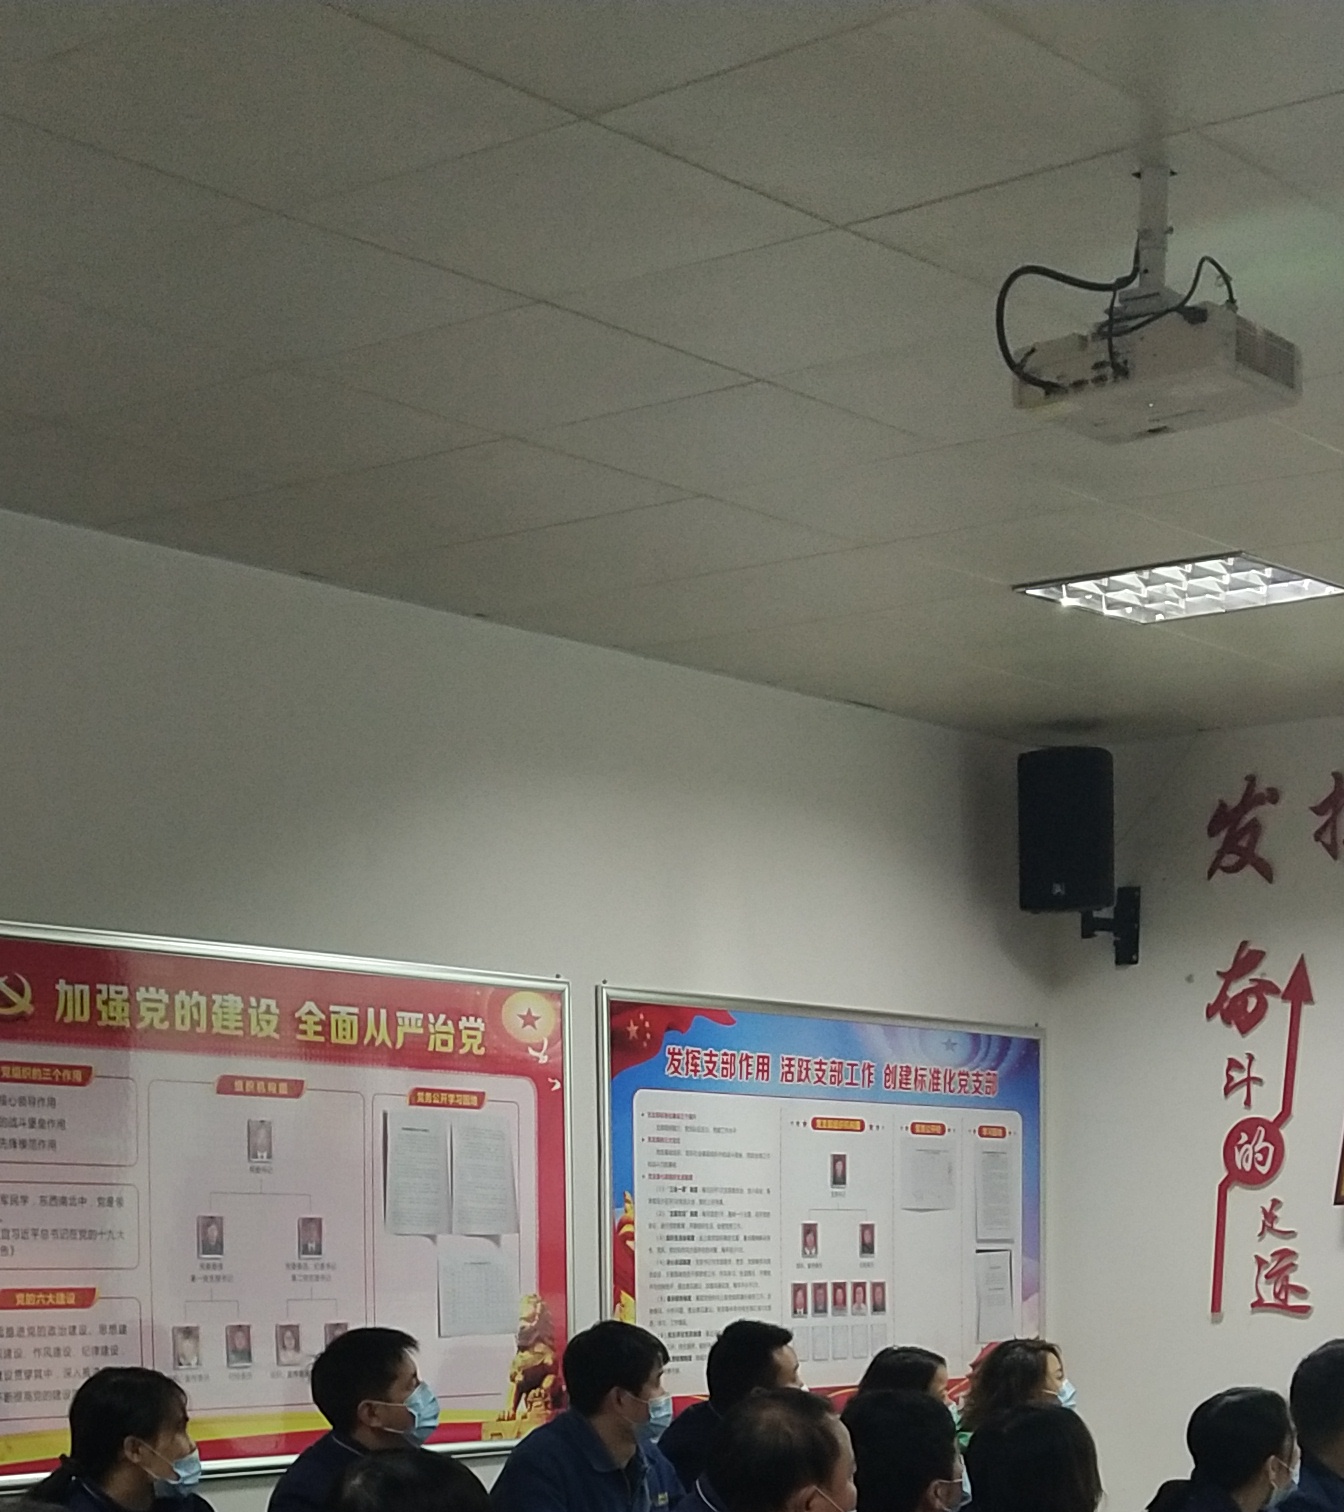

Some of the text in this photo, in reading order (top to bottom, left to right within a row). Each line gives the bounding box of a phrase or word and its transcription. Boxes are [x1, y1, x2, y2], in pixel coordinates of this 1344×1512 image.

[55, 978, 486, 1056] 加强党的建设 全面从严治党
[666, 1046, 998, 1097] 发挥支部作用 活跃支部工作 创建标准化党支部
[15, 1292, 76, 1306] 党的六大建设
